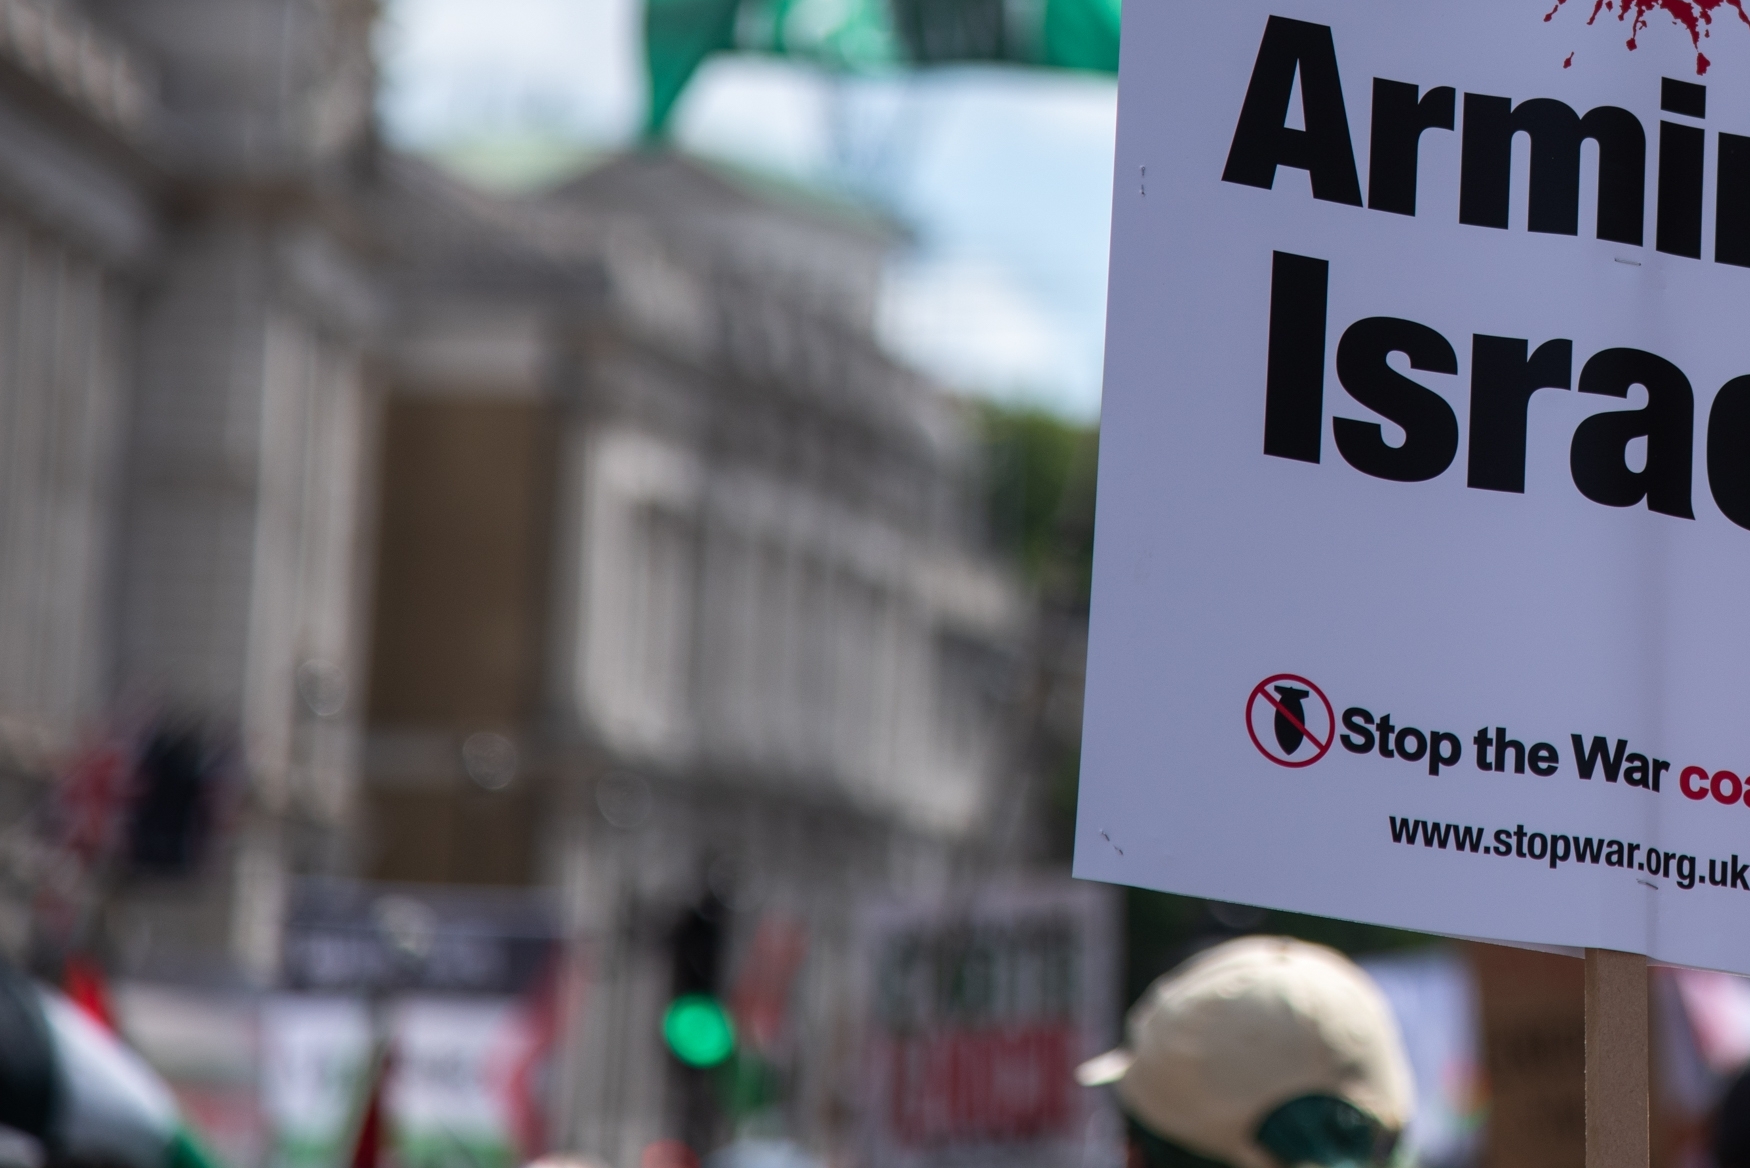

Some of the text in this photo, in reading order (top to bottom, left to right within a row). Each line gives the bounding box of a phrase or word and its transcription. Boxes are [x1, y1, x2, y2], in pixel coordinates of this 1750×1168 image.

[1339, 707, 1462, 777] Stop
[1473, 726, 1560, 777] the
[1570, 733, 1671, 793] War
[1388, 815, 1750, 891] www.stopwar.org.uk
